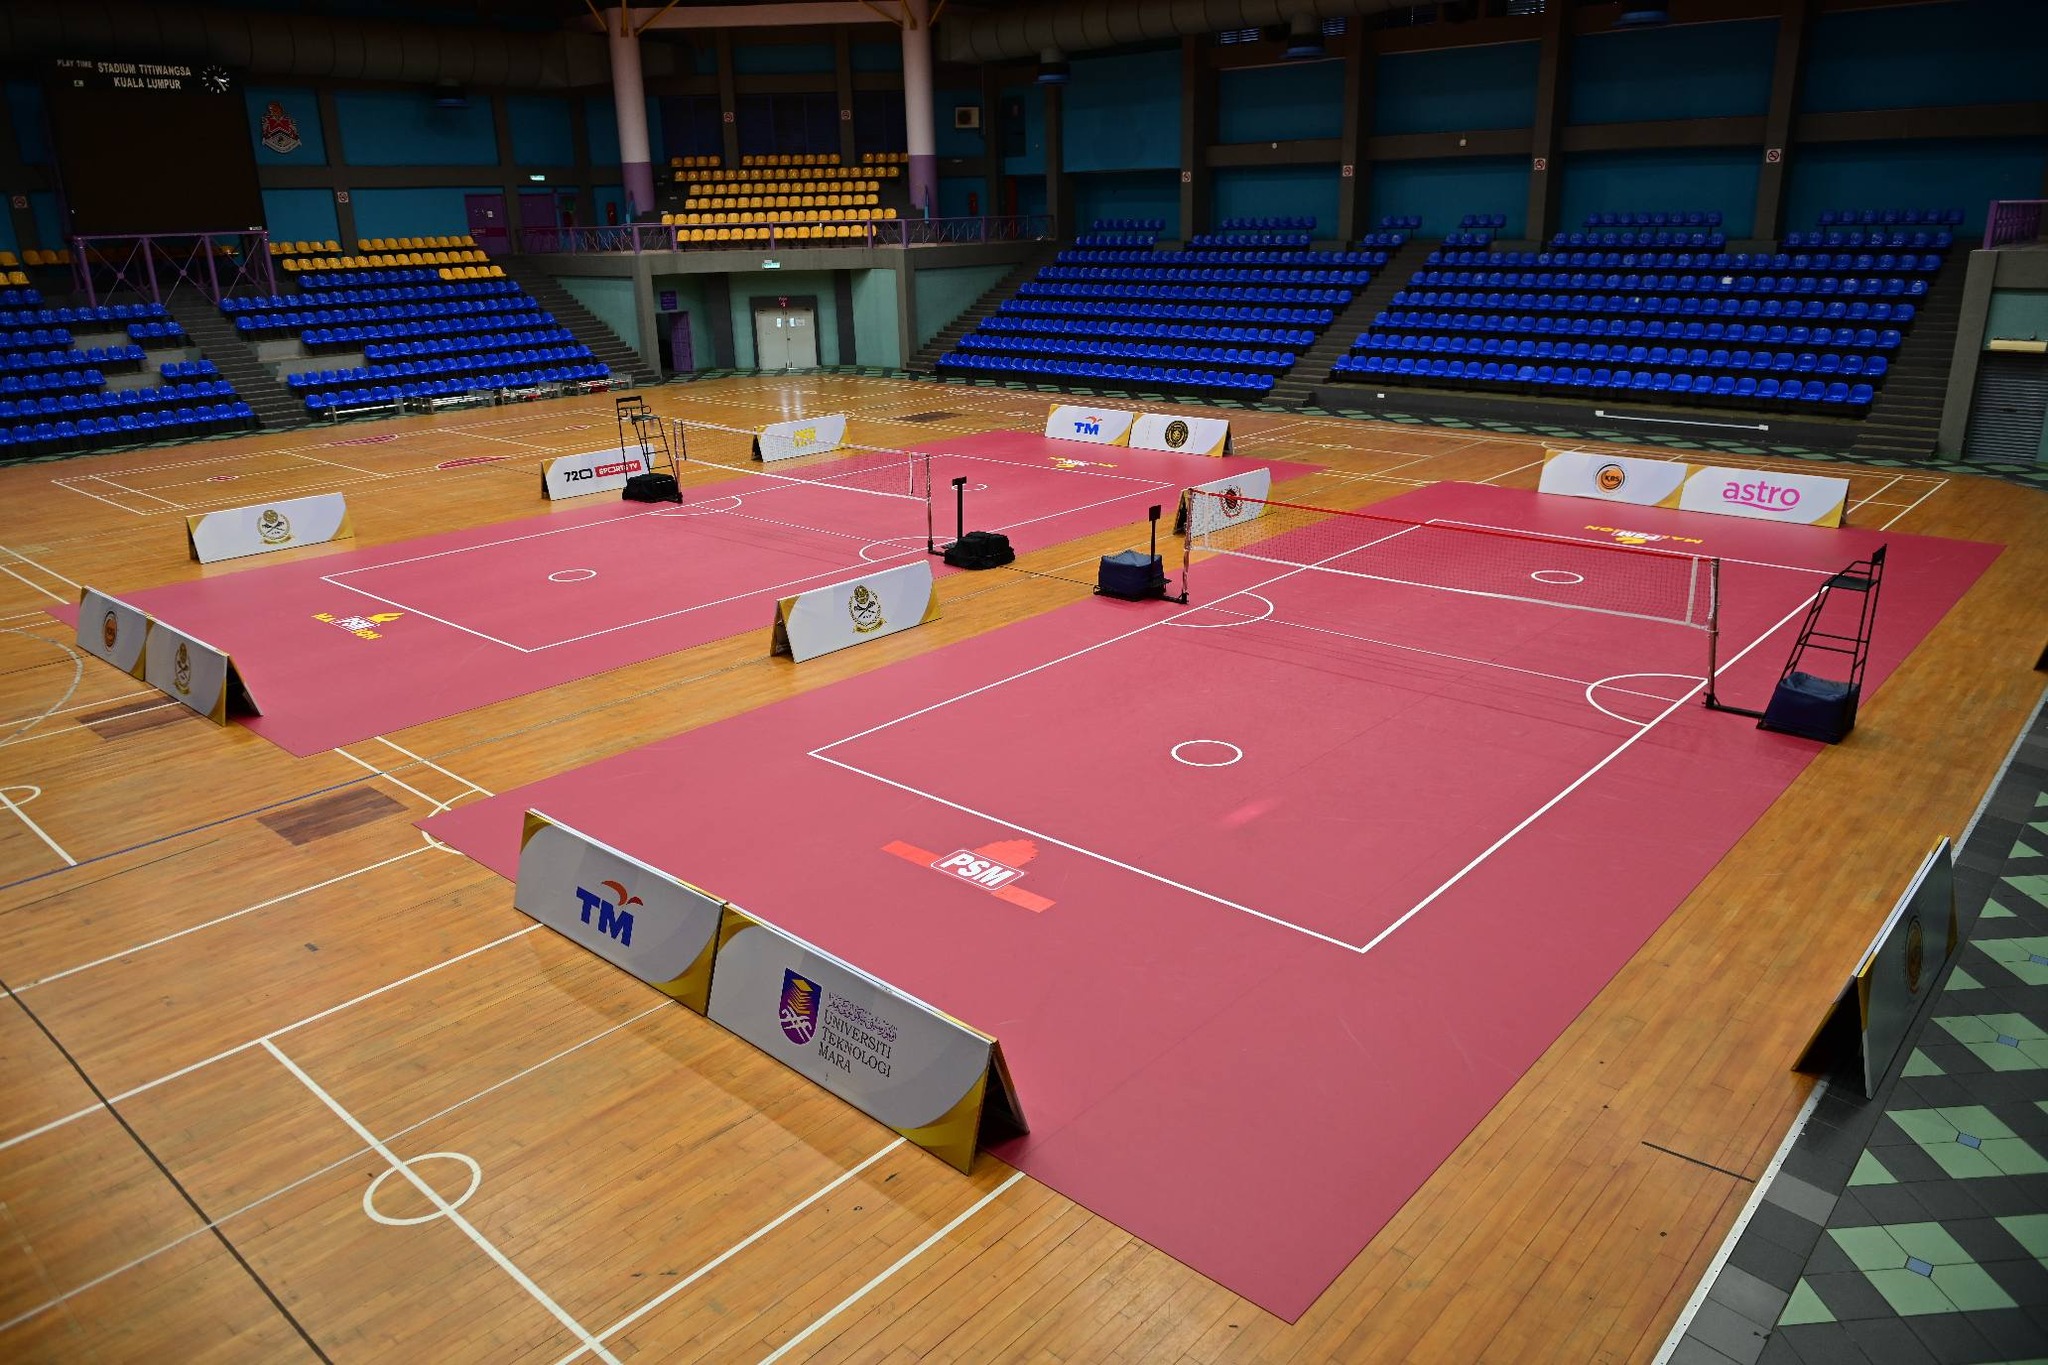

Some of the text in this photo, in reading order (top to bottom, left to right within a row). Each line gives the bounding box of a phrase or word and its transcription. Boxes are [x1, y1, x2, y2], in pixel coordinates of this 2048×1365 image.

[57, 59, 93, 68] PLAY TIME
[97, 62, 192, 76] STADIUM TITIWANGSA
[113, 77, 182, 90] KUALA LUMPUR
[1074, 422, 1100, 435] TM
[1722, 481, 1801, 507] astro
[939, 852, 1016, 887] PSM
[576, 886, 634, 948] TM
[823, 1009, 892, 1059] UNIVERSITI
[818, 1042, 851, 1073] MARA
[822, 1026, 892, 1078] TEKNOLOGI
